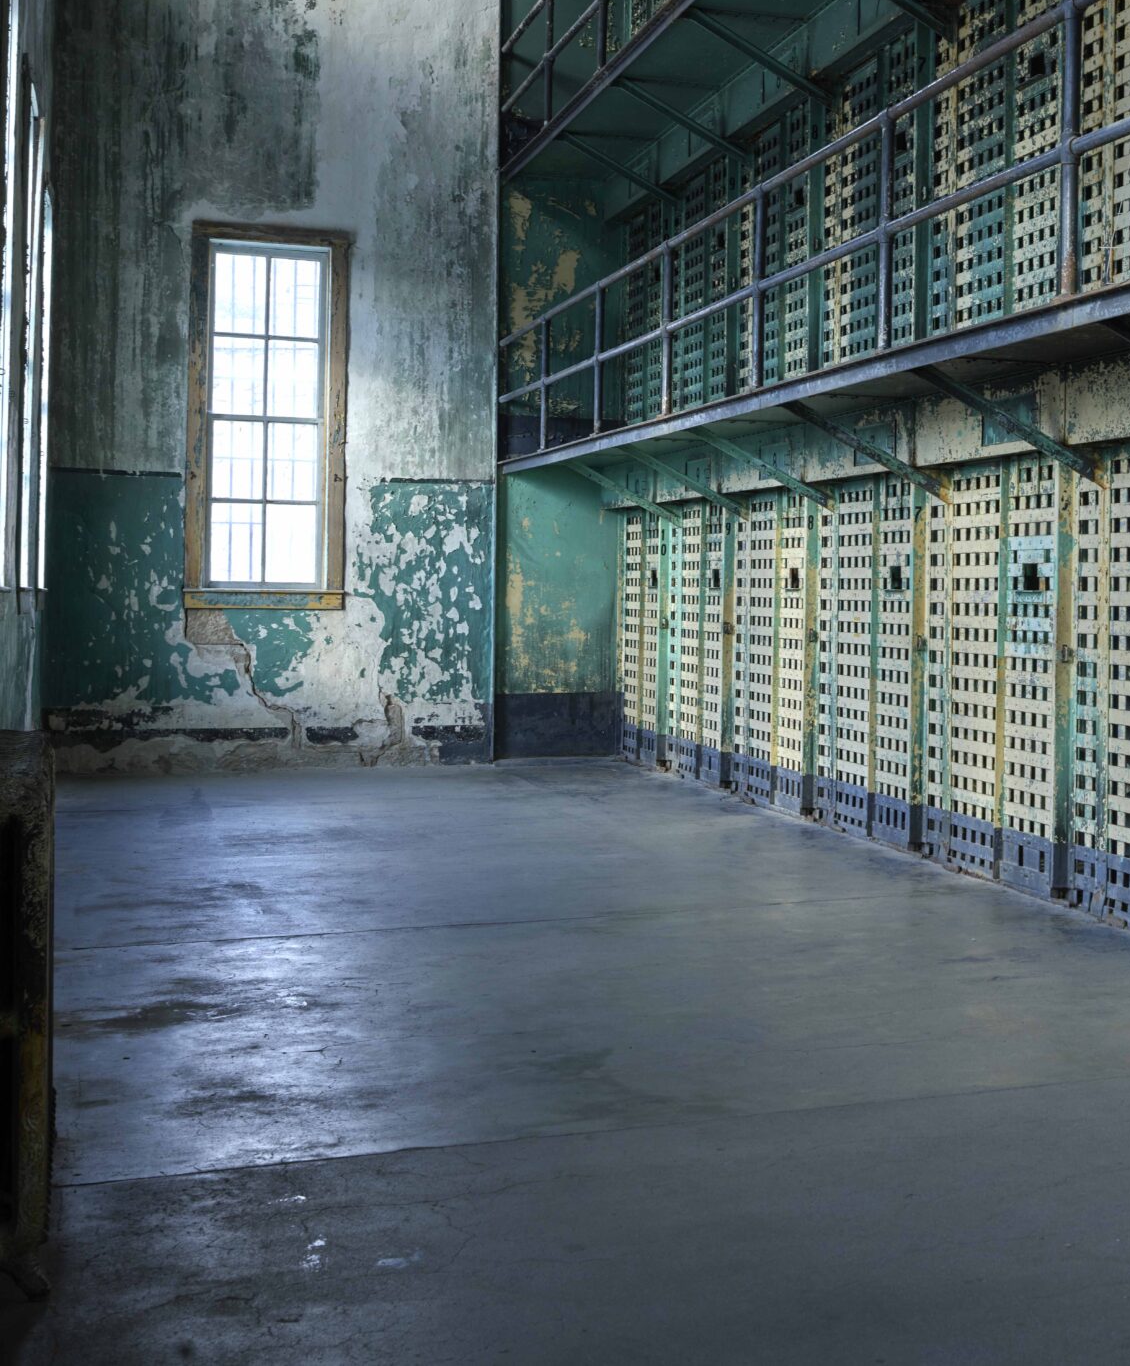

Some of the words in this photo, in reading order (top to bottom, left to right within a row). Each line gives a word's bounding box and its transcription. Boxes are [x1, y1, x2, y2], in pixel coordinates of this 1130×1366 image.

[918, 56, 927, 73] 7
[807, 514, 815, 531] 8
[914, 506, 923, 523] 7
[725, 522, 732, 536] 9
[660, 528, 668, 556] 10
